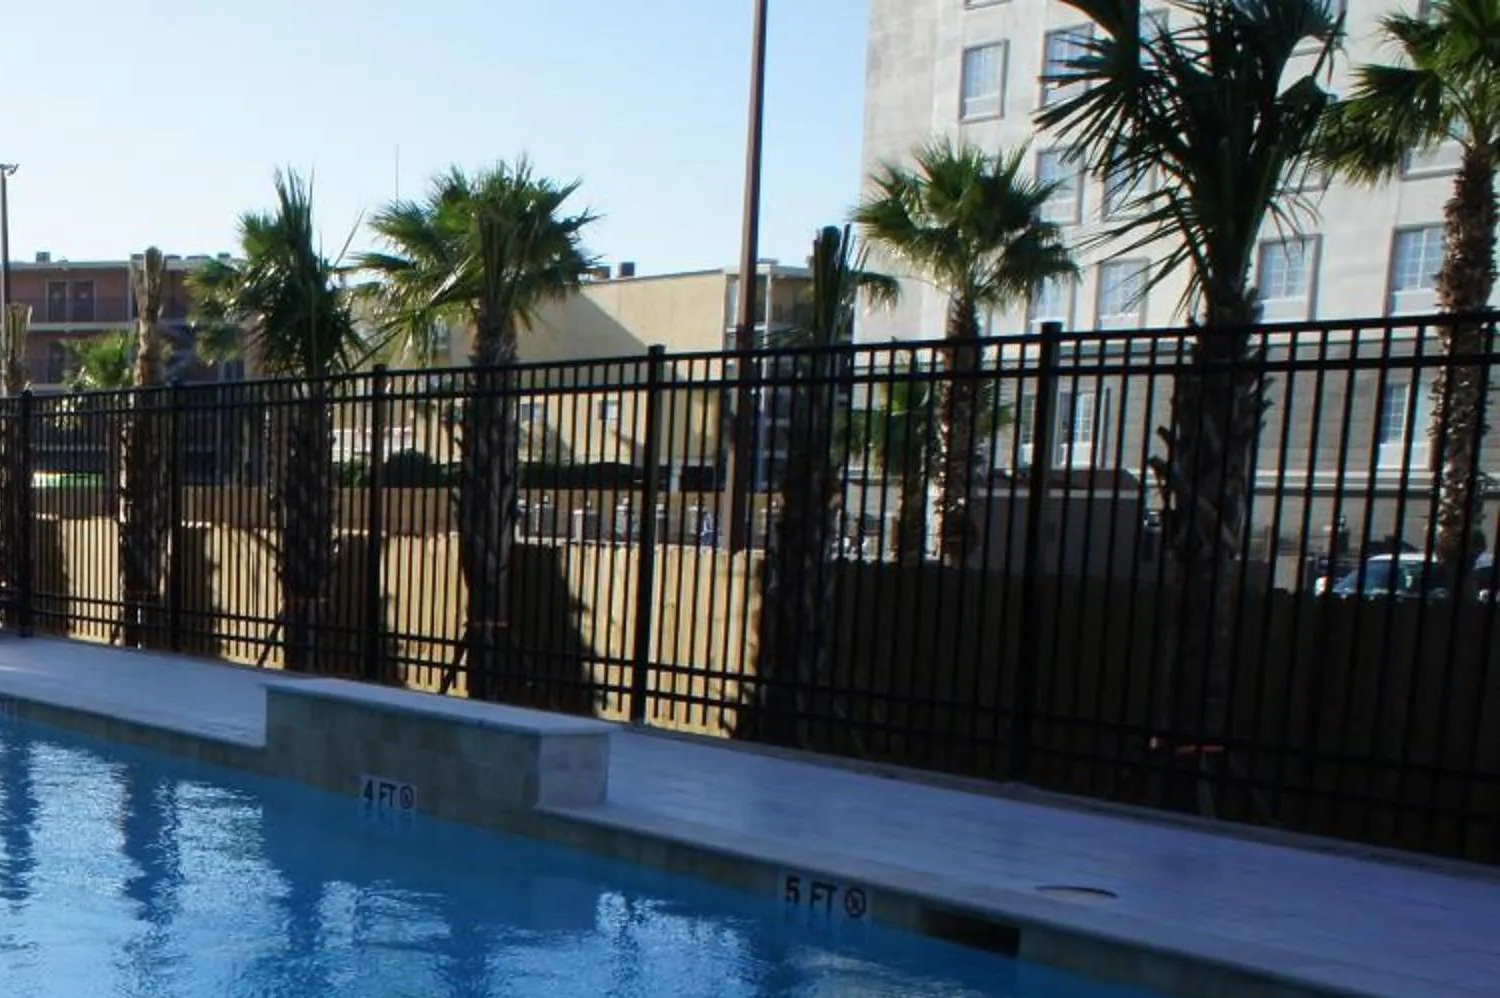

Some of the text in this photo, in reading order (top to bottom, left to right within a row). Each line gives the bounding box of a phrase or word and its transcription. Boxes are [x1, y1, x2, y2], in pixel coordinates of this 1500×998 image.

[363, 779, 398, 807] 4 FT
[784, 875, 838, 914] 5 FT
